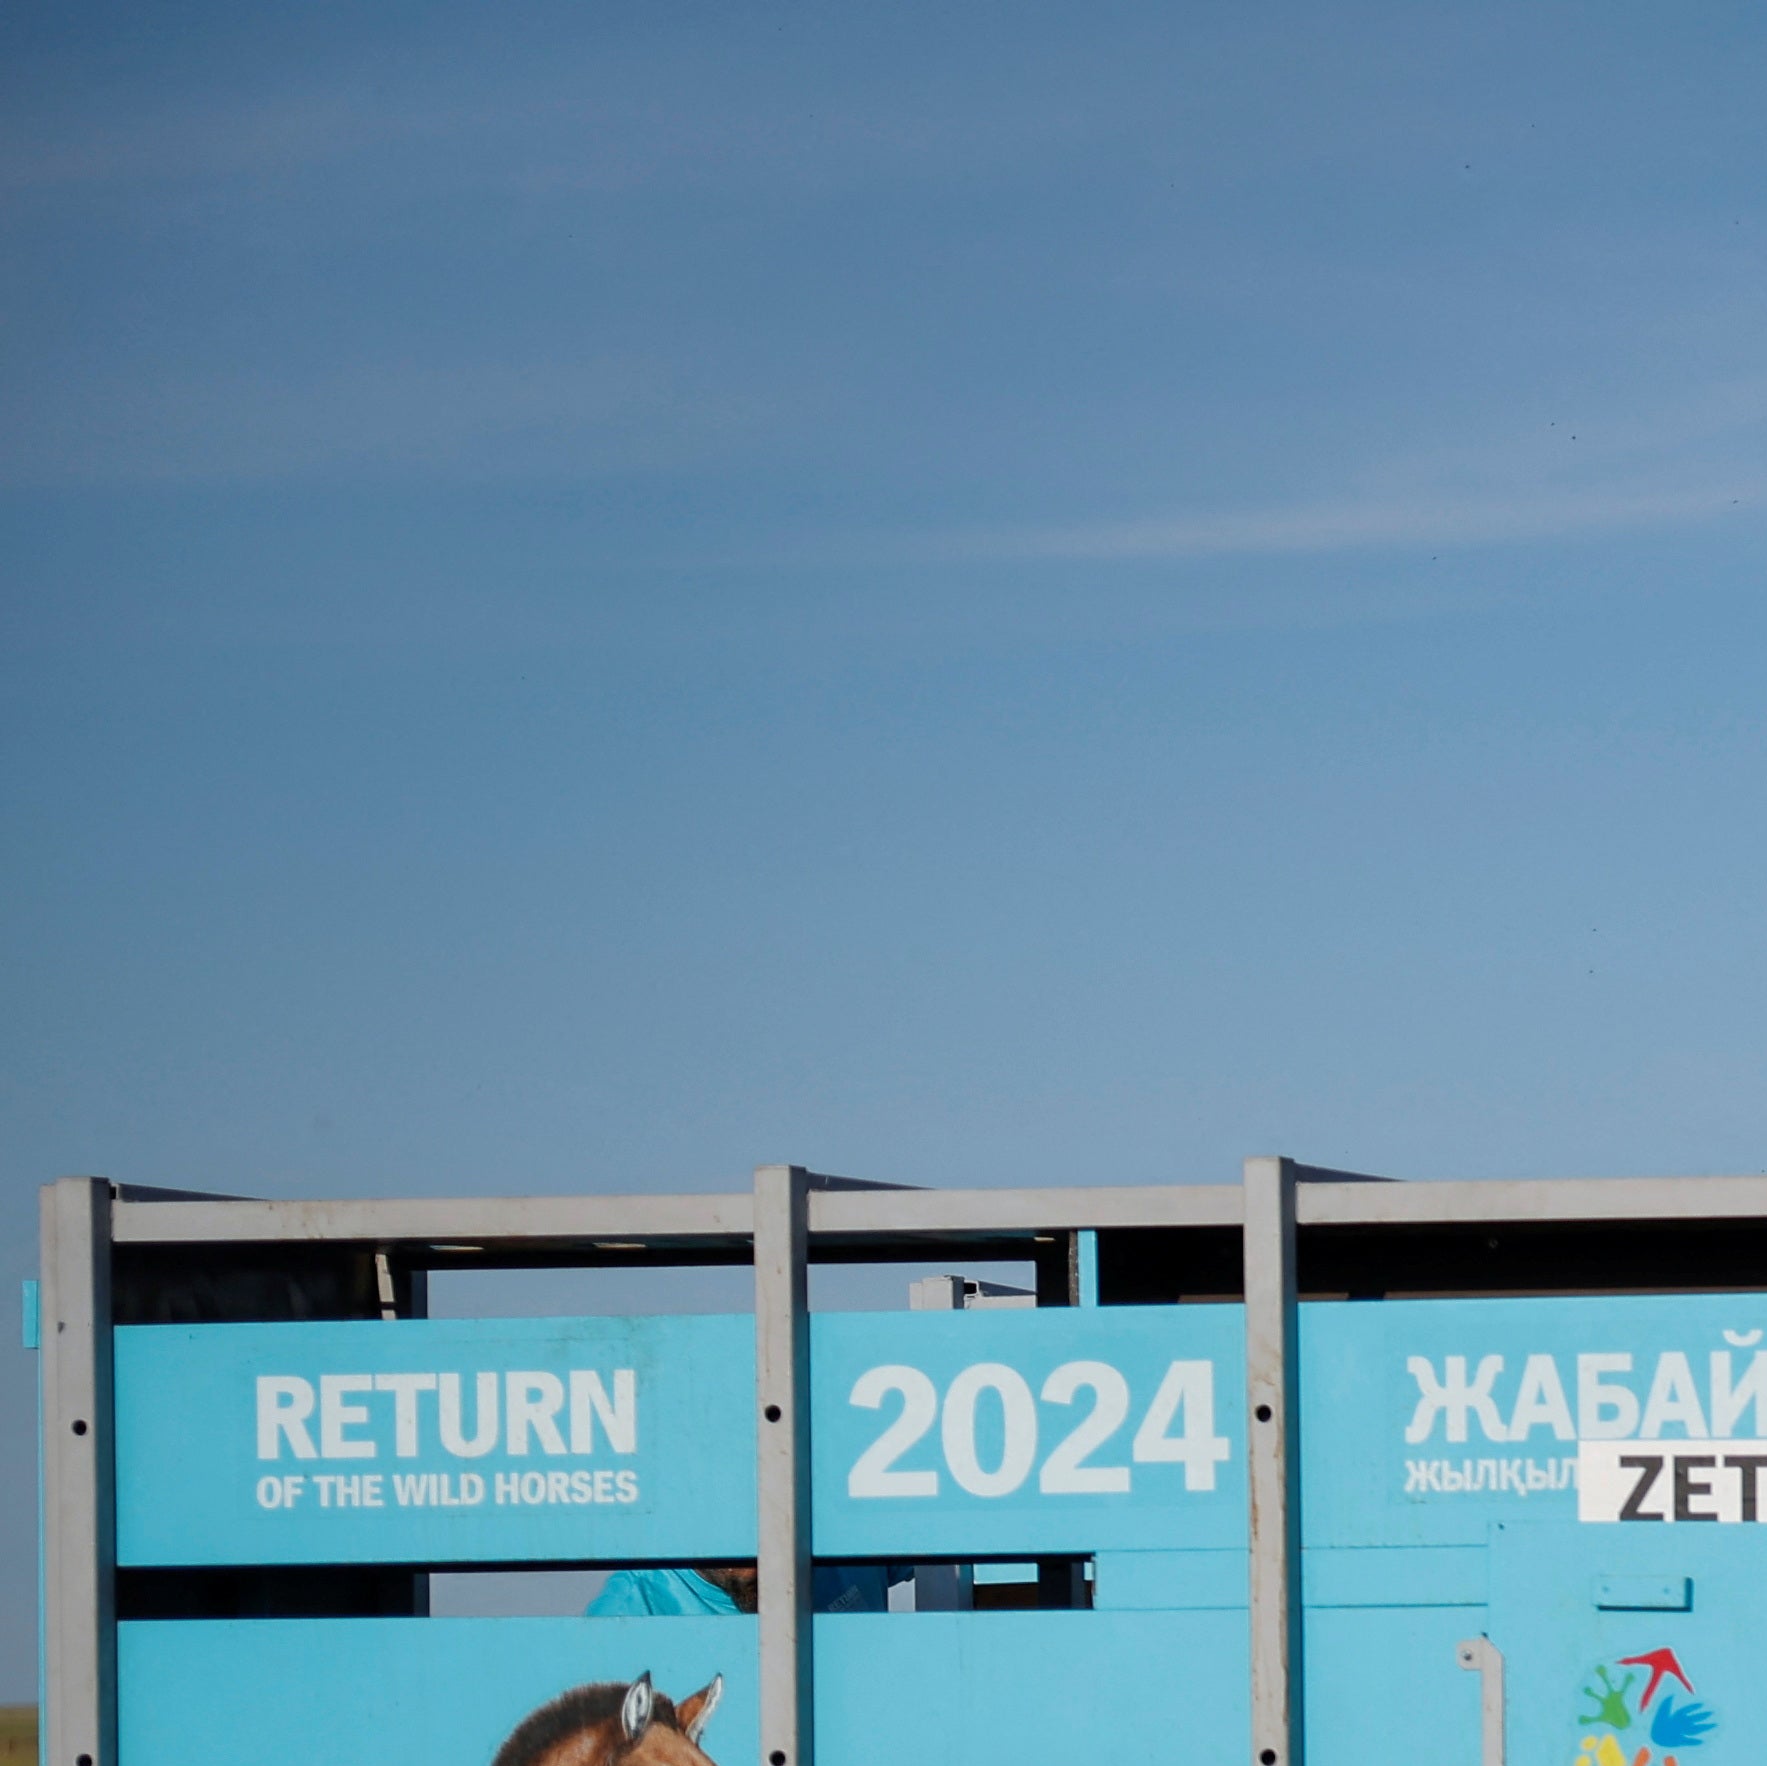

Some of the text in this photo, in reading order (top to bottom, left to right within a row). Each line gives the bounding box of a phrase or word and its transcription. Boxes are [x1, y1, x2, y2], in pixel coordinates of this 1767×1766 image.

[256, 1369, 637, 1459] RETURN
[847, 1360, 1231, 1499] 2024
[256, 1470, 639, 1508] OF THE WILD HORSES
